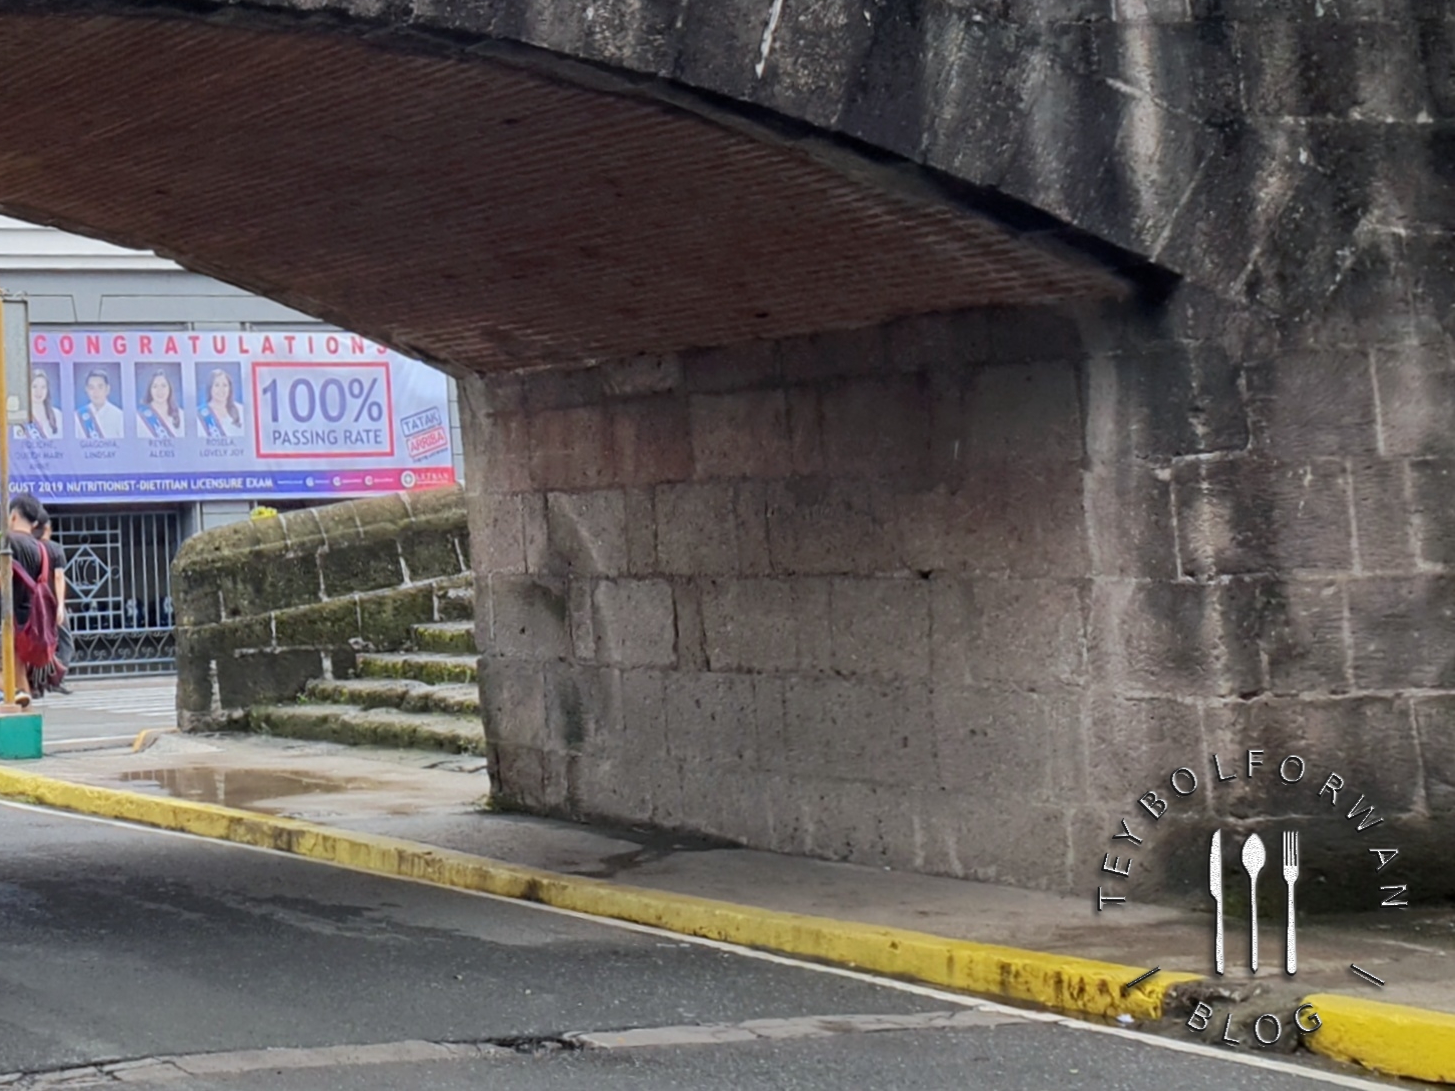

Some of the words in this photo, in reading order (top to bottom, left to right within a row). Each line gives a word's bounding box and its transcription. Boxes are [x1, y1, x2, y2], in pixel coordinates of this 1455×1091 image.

[262, 377, 383, 423] 100%
[403, 412, 439, 433] TATAK
[273, 430, 338, 445] PASSING
[345, 429, 383, 444] RATE
[410, 431, 444, 453] ARRIBA
[38, 480, 64, 492] 2019
[190, 476, 244, 489] LICENSURE
[246, 475, 274, 488] EXAM
